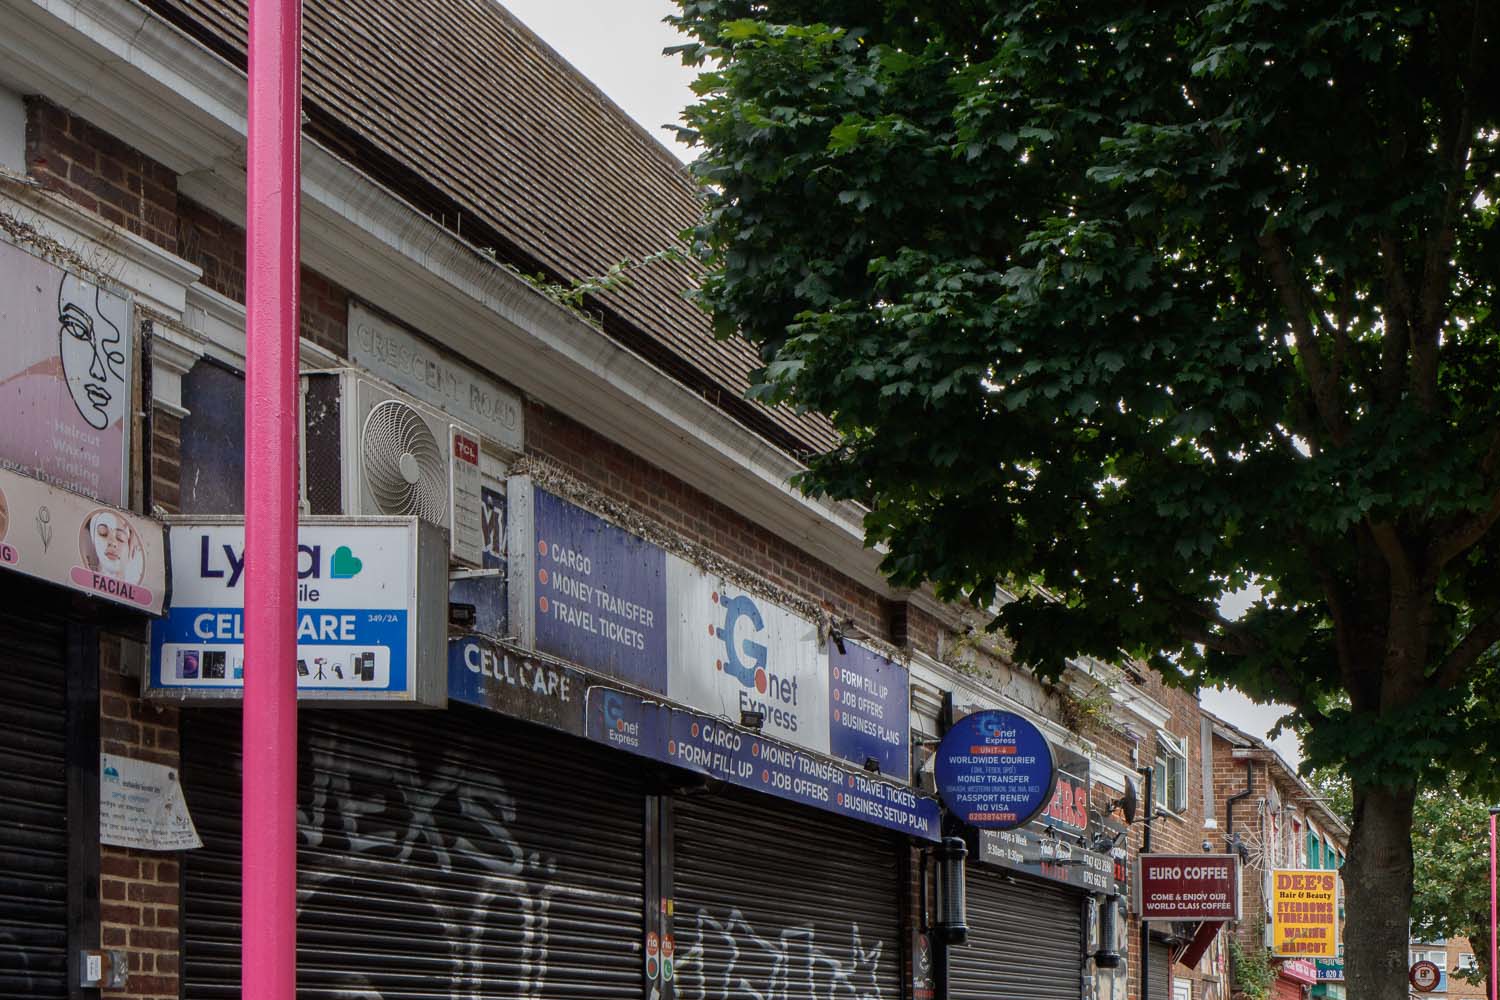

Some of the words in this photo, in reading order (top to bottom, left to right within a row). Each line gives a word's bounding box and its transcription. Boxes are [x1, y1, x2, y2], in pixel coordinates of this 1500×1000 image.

[54, 419, 100, 447] Haircut
[53, 437, 99, 466] Waxing
[456, 441, 475, 458] TCL
[201, 535, 320, 588] Lya
[552, 544, 591, 575] CARGO
[92, 574, 135, 600] FACIAL
[553, 572, 593, 604] MONEY
[595, 589, 654, 628] TRANSFER
[194, 613, 244, 640] CEL
[299, 614, 356, 641] ARE
[367, 614, 398, 624] 349/2A
[552, 600, 597, 634] TRAVEL
[599, 618, 645, 650] TICKETS
[464, 643, 515, 685] CELL
[520, 662, 570, 702] CARE
[841, 668, 862, 687] FORM
[864, 676, 878, 696] FILL
[879, 685, 888, 700] UP
[842, 691, 856, 708] JOB
[858, 699, 883, 719] OFFERS
[609, 730, 639, 748] Express
[842, 713, 877, 739] BUSINESS
[878, 725, 900, 745] PLANS
[985, 737, 1016, 746] Express
[702, 725, 741, 751] CARGO
[760, 743, 798, 770] MONEY
[798, 755, 843, 785] TRANSFER
[856, 775, 885, 799] TRAVEL
[886, 786, 916, 809] TICKETS
[949, 756, 999, 764] WORLDWIDE
[1000, 756, 1036, 764] COURIER
[678, 742, 711, 768] FORM
[713, 754, 735, 776] FILL
[738, 762, 753, 779] UP
[771, 771, 792, 791] JOB
[793, 777, 829, 802] OFFERS
[844, 792, 883, 818] BUSINESS
[884, 805, 908, 825] SETUP
[908, 813, 928, 832] PLAN
[957, 794, 998, 802] PASSPORT
[1000, 794, 1029, 802] RENEW
[1149, 867, 1181, 880] EURO
[1184, 867, 1228, 880] COFFEE
[1277, 874, 1334, 891] DEE'S
[1278, 902, 1333, 912] EYEBROWS
[1306, 892, 1331, 900] Beauty
[1282, 942, 1327, 953] HAIRCUT
[1326, 970, 1336, 978] 020
